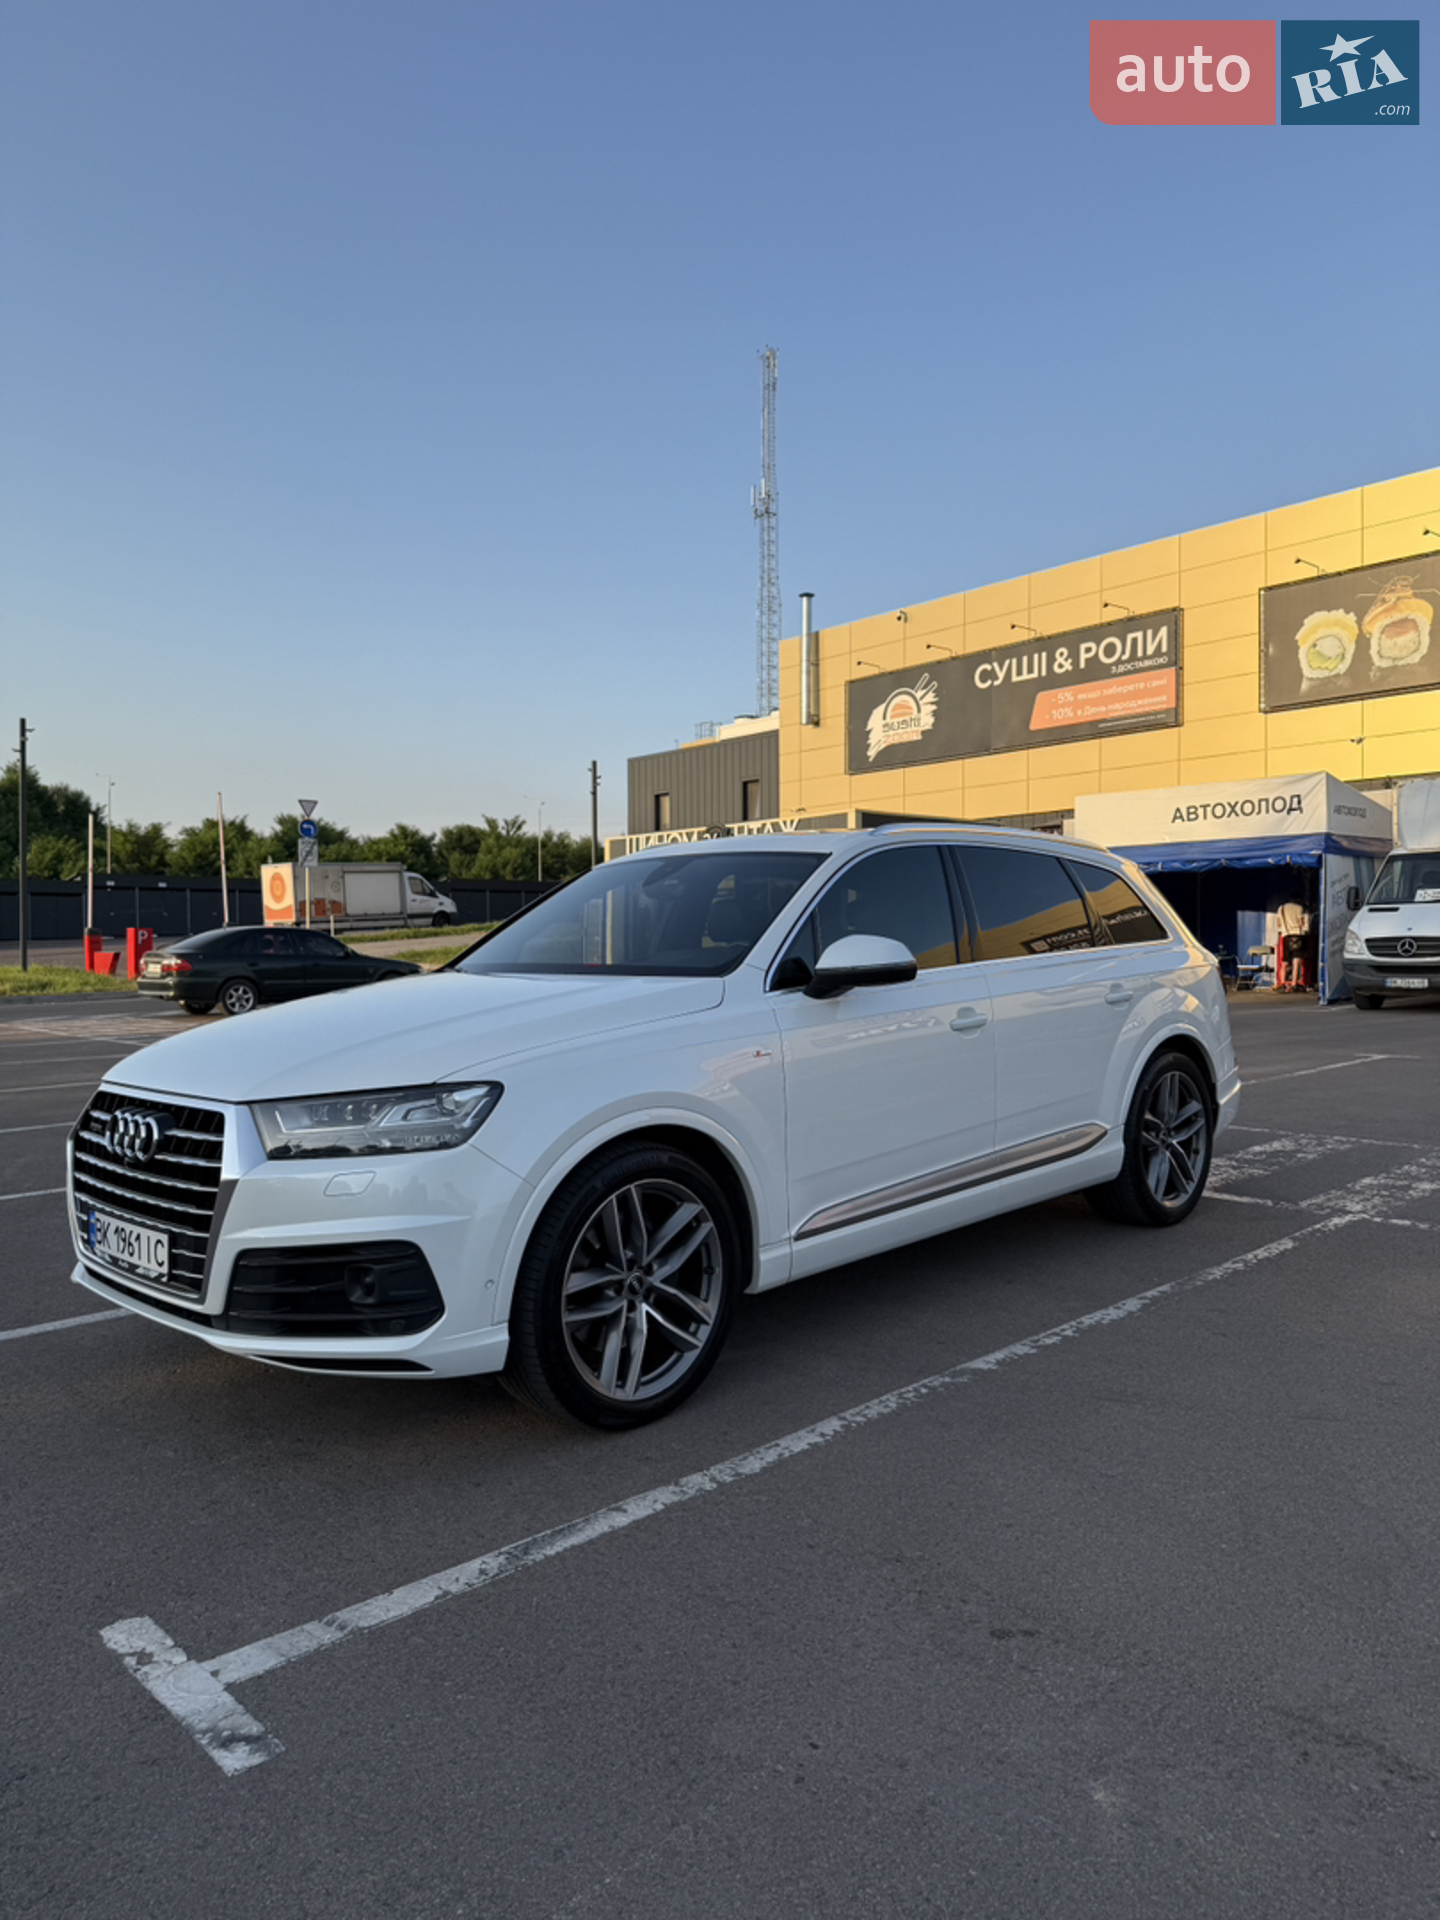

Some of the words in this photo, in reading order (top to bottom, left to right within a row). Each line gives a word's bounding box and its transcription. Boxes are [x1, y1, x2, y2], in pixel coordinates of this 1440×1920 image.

[974, 651, 1047, 689] СУШІ
[1052, 646, 1073, 674] &
[1079, 625, 1168, 670] РОЛИ
[1171, 794, 1304, 823] АВТОХОЛОД
[137, 929, 148, 946] P
[113, 1225, 141, 1261] 1961
[147, 1235, 165, 1268] IC
